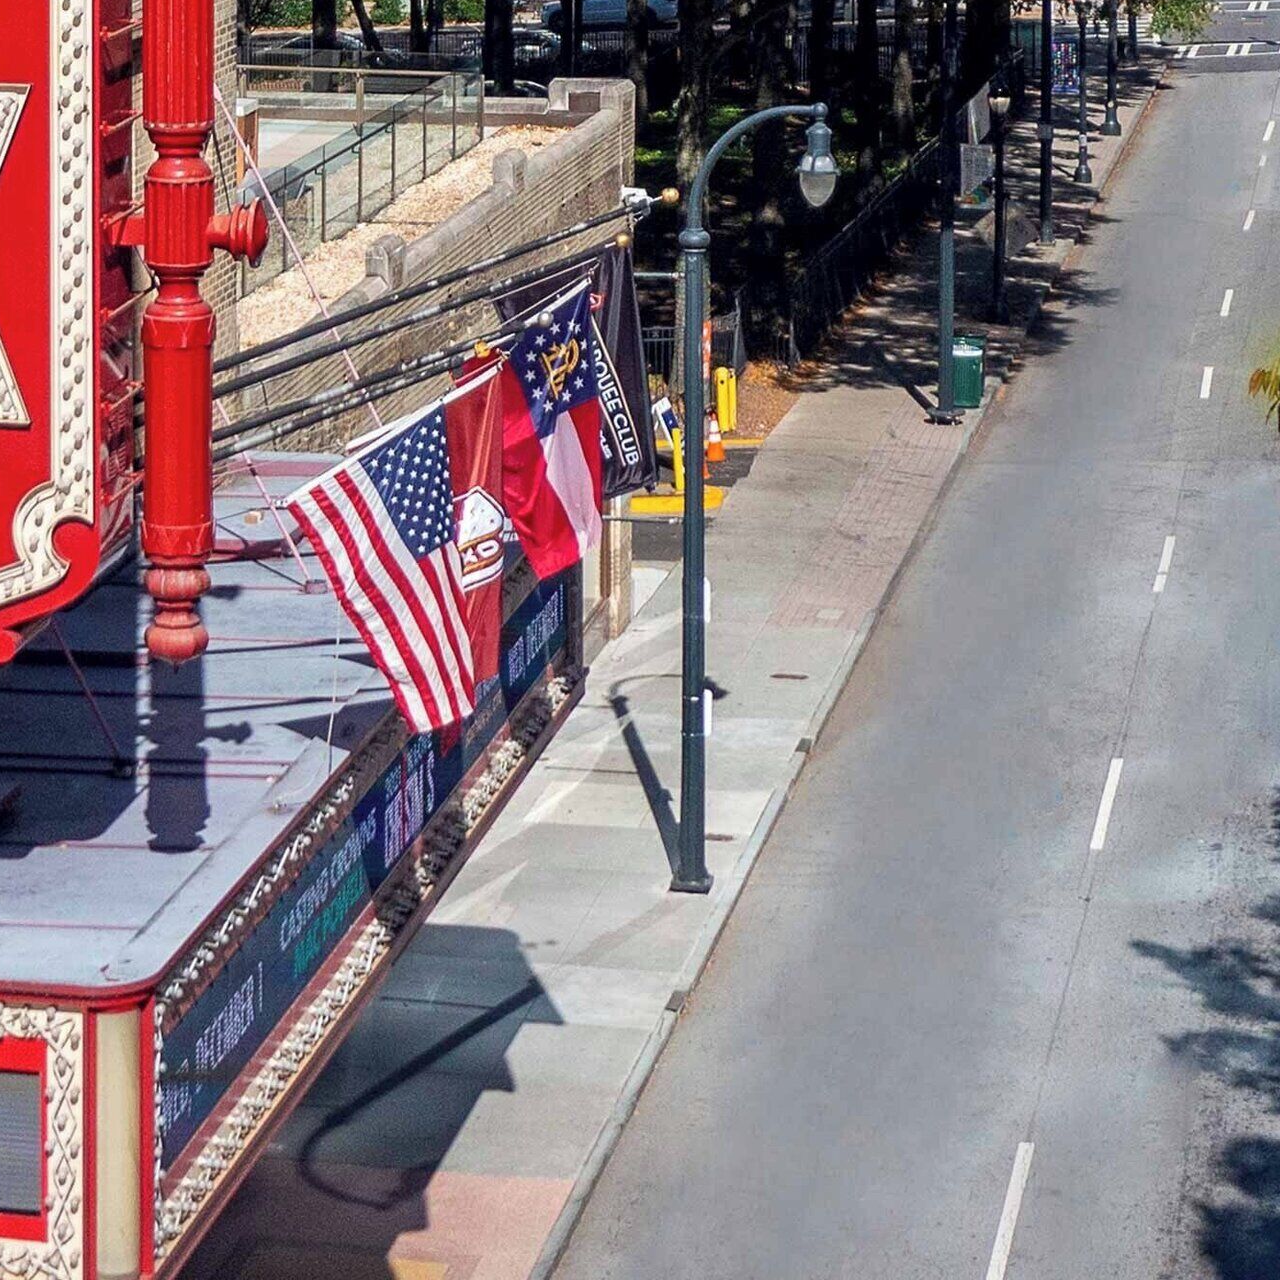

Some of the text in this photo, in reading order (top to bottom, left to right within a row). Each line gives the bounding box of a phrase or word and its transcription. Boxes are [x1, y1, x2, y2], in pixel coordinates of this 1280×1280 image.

[614, 413, 640, 465] CLUB
[384, 750, 436, 869] CHRISTMS
[196, 973, 255, 1095] DECEMBER
